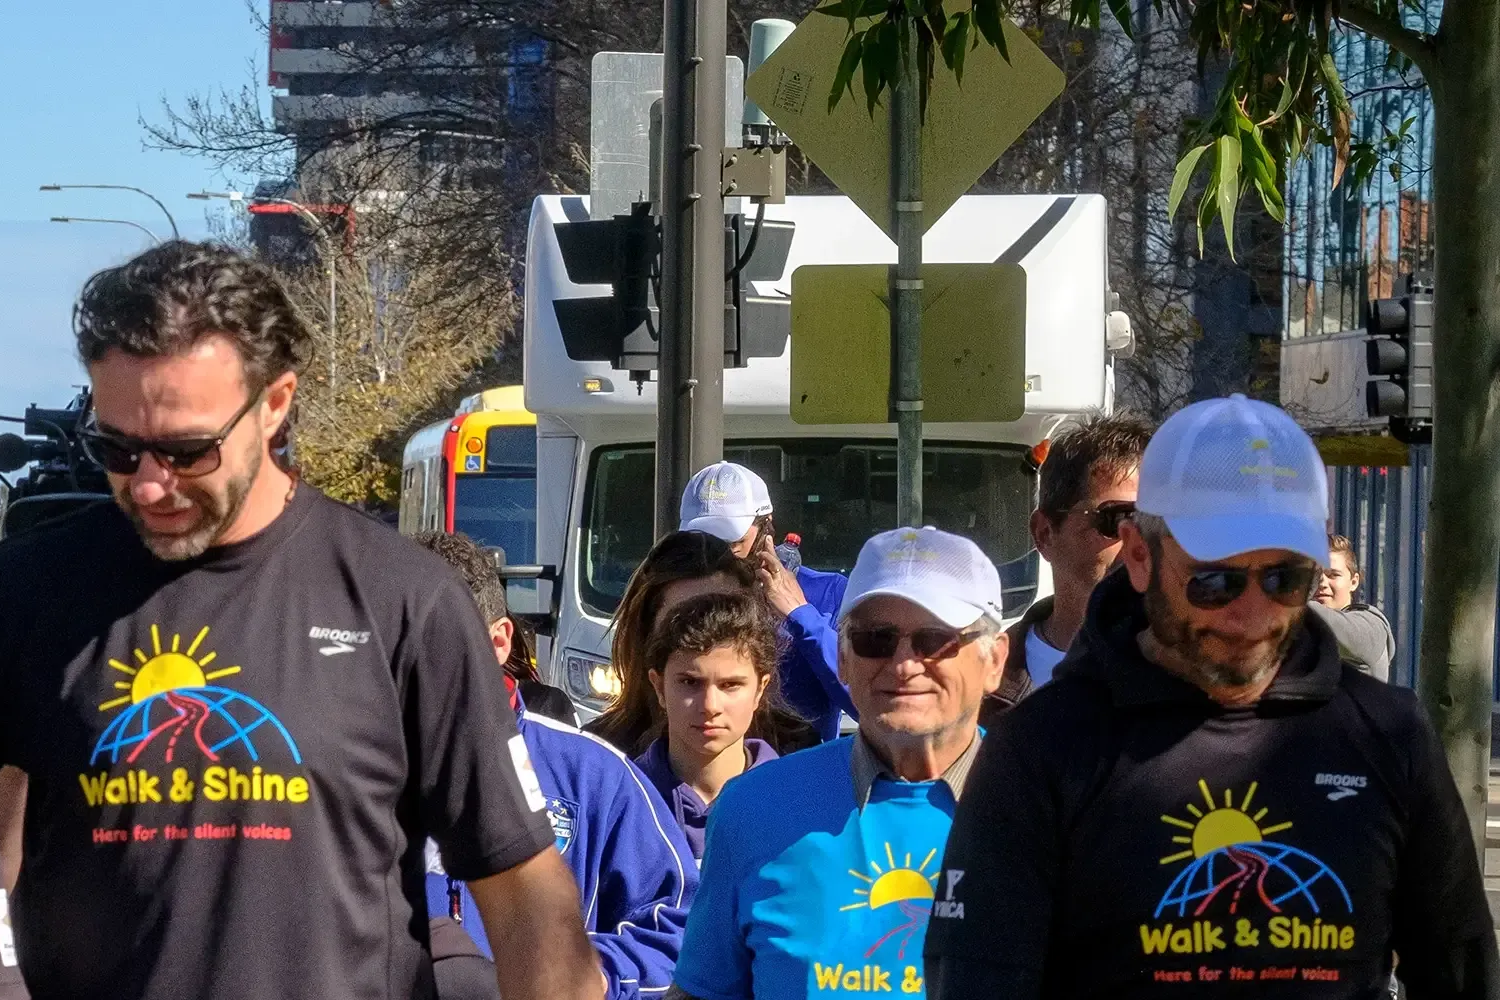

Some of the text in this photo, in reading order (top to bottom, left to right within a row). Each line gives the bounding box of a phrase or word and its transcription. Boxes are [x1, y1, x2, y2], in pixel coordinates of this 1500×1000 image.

[309, 626, 371, 644] BROOKS
[78, 765, 309, 807] Walk & Shine
[1314, 773, 1368, 788] BROOKS
[92, 822, 292, 844] Here for the silent voices
[1139, 915, 1355, 955] Walk & Shine
[814, 962, 924, 993] Walk &
[1154, 965, 1340, 982] Here for the silent voices
